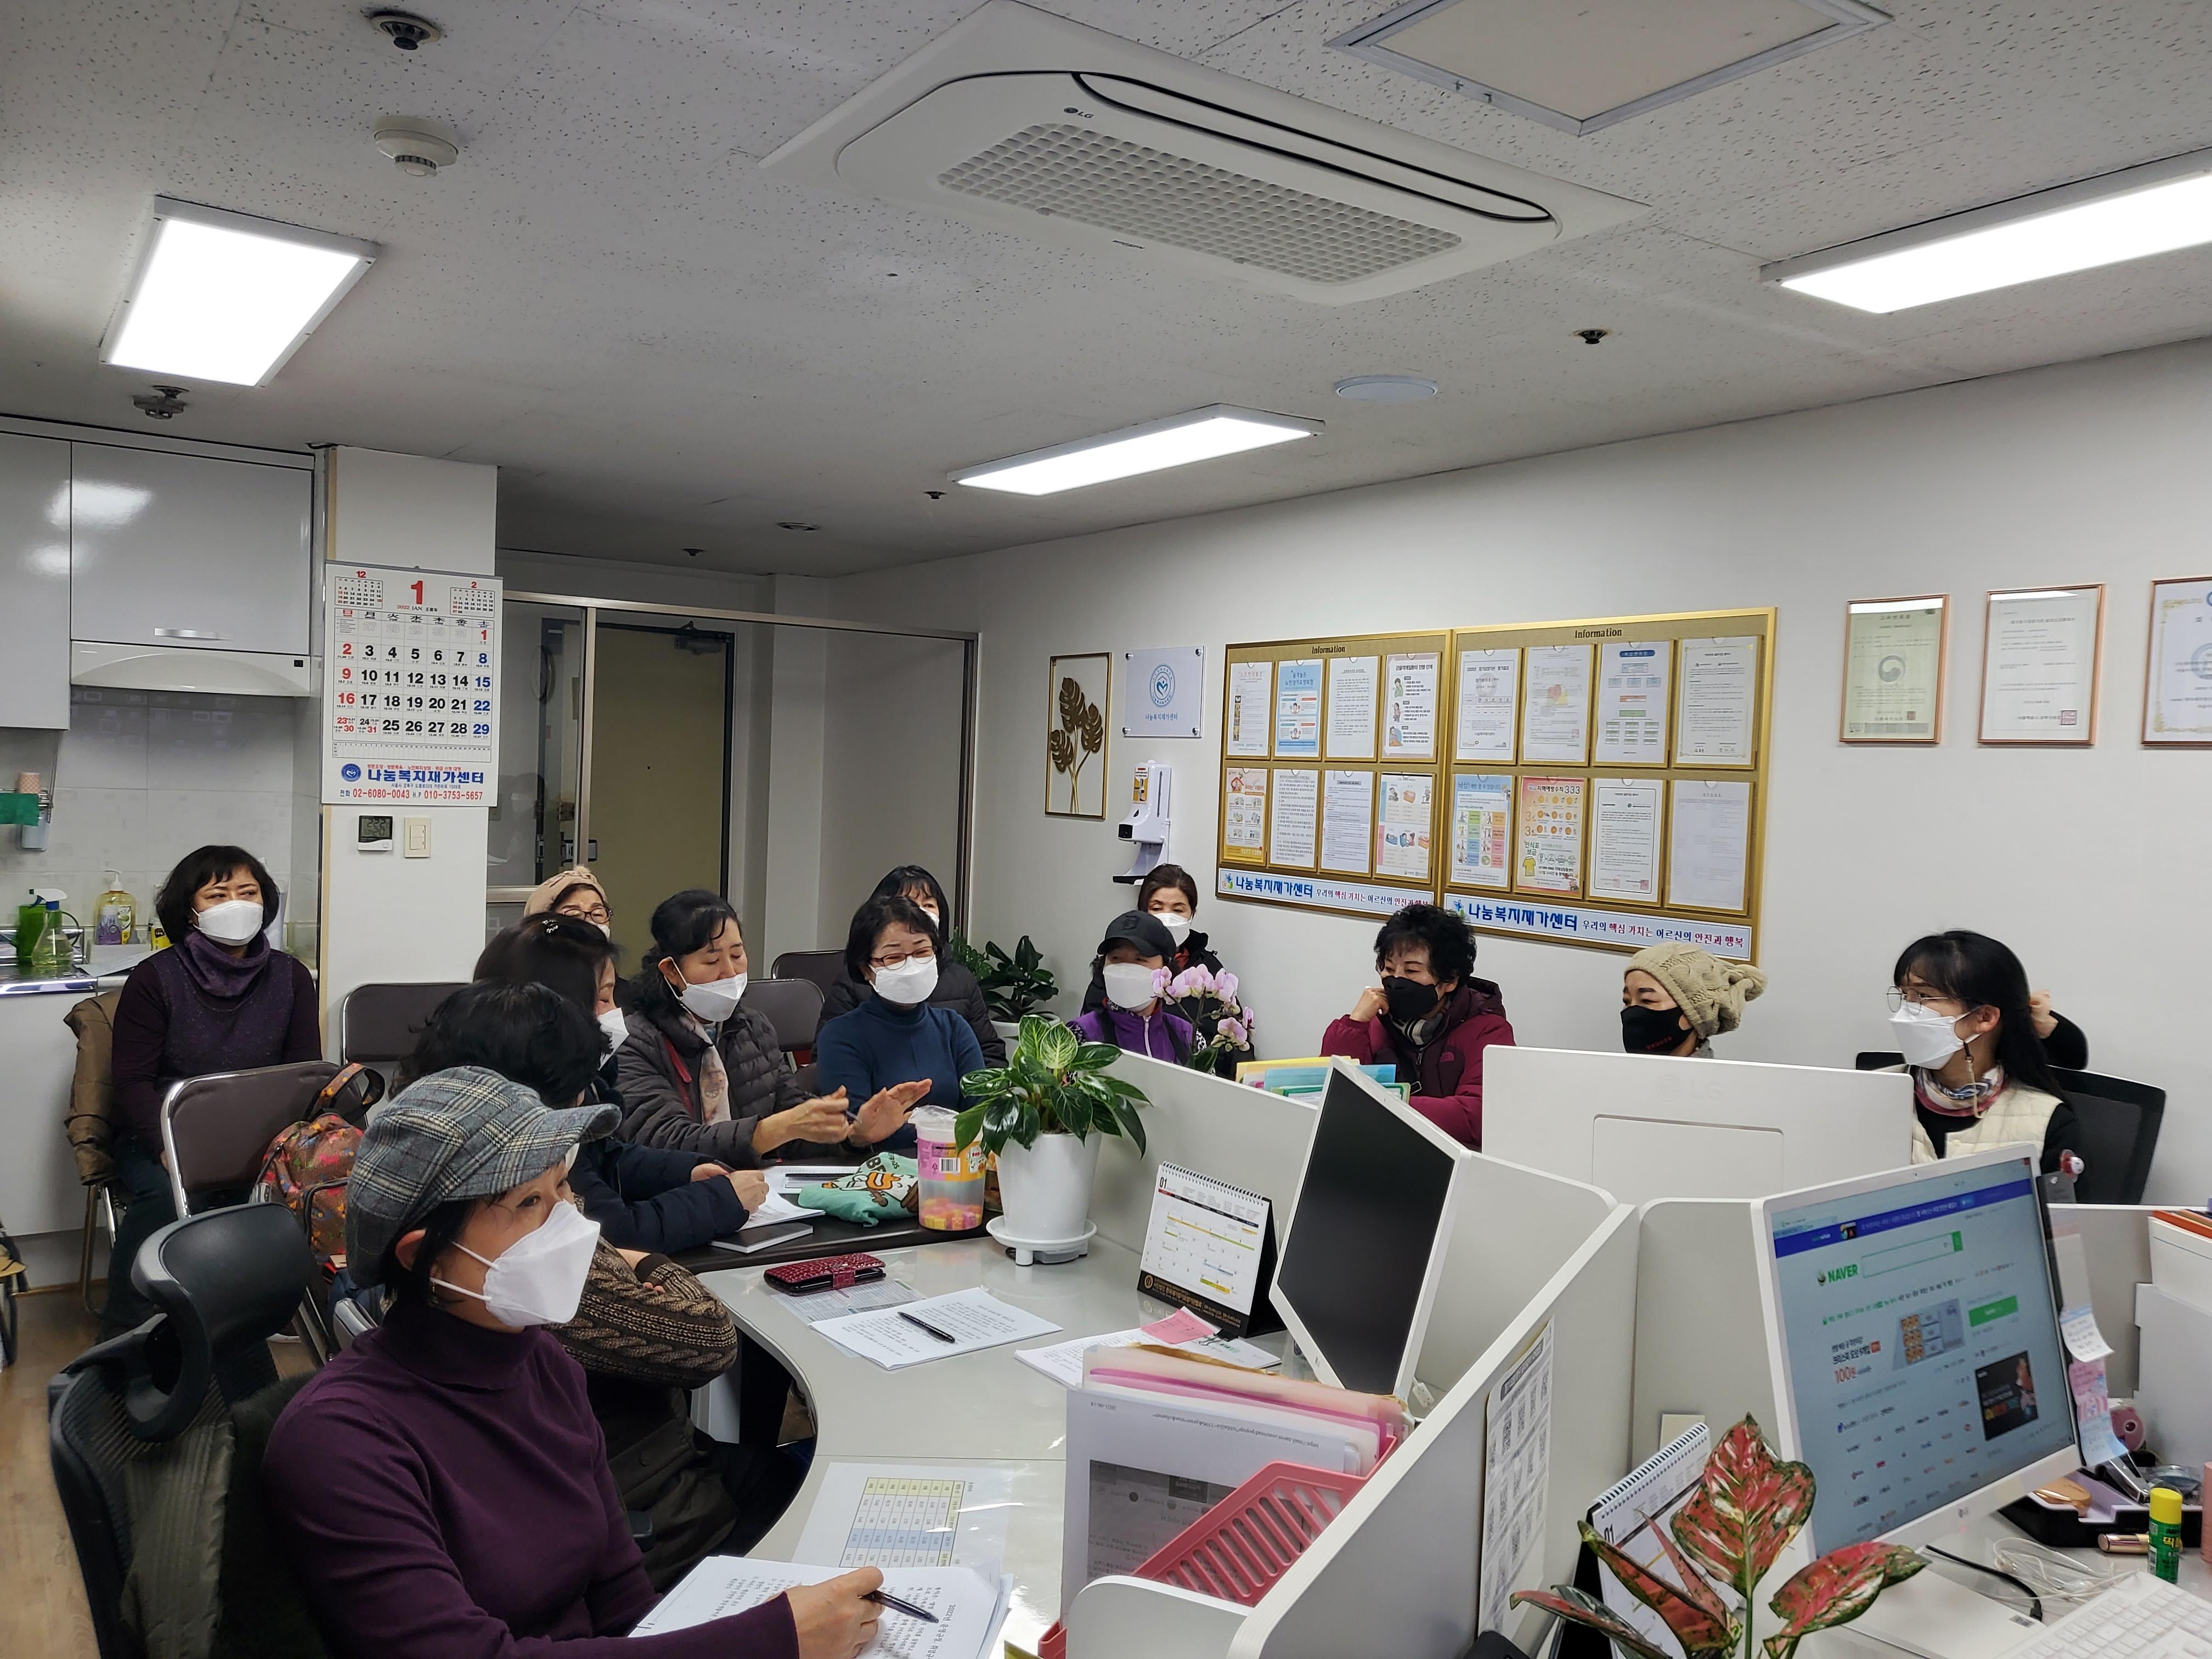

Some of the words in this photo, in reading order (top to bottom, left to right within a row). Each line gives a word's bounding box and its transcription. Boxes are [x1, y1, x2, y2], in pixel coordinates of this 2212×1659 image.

[410, 580, 423, 605] 1
[481, 629, 487, 641] 1
[1575, 628, 1622, 639] Information
[342, 643, 352, 655] 2
[365, 645, 374, 657] 3
[388, 647, 397, 658] 4
[410, 648, 420, 659] 5
[434, 650, 443, 661] 6
[456, 651, 465, 663] 7
[478, 653, 488, 664] 8
[1312, 645, 1346, 654] Information
[342, 668, 352, 680] 9
[361, 669, 378, 681] 10
[384, 671, 399, 683] 11
[407, 672, 424, 684] 12
[430, 674, 446, 685] 13
[453, 675, 469, 687] 14
[475, 676, 490, 688] 15
[338, 692, 356, 704] 16
[360, 694, 377, 706] 17
[384, 695, 400, 707] 18
[407, 696, 423, 708] 19
[428, 697, 445, 709] 20
[451, 698, 466, 710] 21
[473, 700, 490, 712] 22
[1145, 713, 1178, 721] 나눔복지재가센터
[382, 719, 400, 731] 25
[405, 720, 422, 732] 26
[428, 721, 445, 733] 27
[450, 723, 467, 734] 28
[473, 724, 489, 735] 29
[368, 769, 484, 784] 나눔복지재가센터
[1458, 781, 1470, 789] 낙상!
[1564, 785, 1581, 794] 333
[353, 788, 410, 799] 02-6080-0043
[424, 790, 483, 800] 010-3753-5657
[1525, 811, 1532, 822] 3
[1525, 826, 1531, 837] 3
[1236, 876, 1313, 899] 나눔복지재가센터
[1316, 888, 1333, 898] 우리의
[1335, 891, 1347, 900] 핵심
[1348, 892, 1365, 902] 가치는
[1368, 894, 1393, 906] 어르신의
[1469, 903, 1577, 932] 나눔복지재가센터
[1582, 919, 1606, 932] 우리의
[1609, 923, 1626, 934] 핵심
[1628, 925, 1654, 938] 가치는
[1656, 928, 1691, 941] 어르신의
[1694, 932, 1722, 946] 안전과
[1725, 936, 1744, 948] 행복
[1159, 1176, 1167, 1189] 01
[1827, 1263, 1859, 1284] NAVER
[943, 1604, 956, 1621] 2022년
